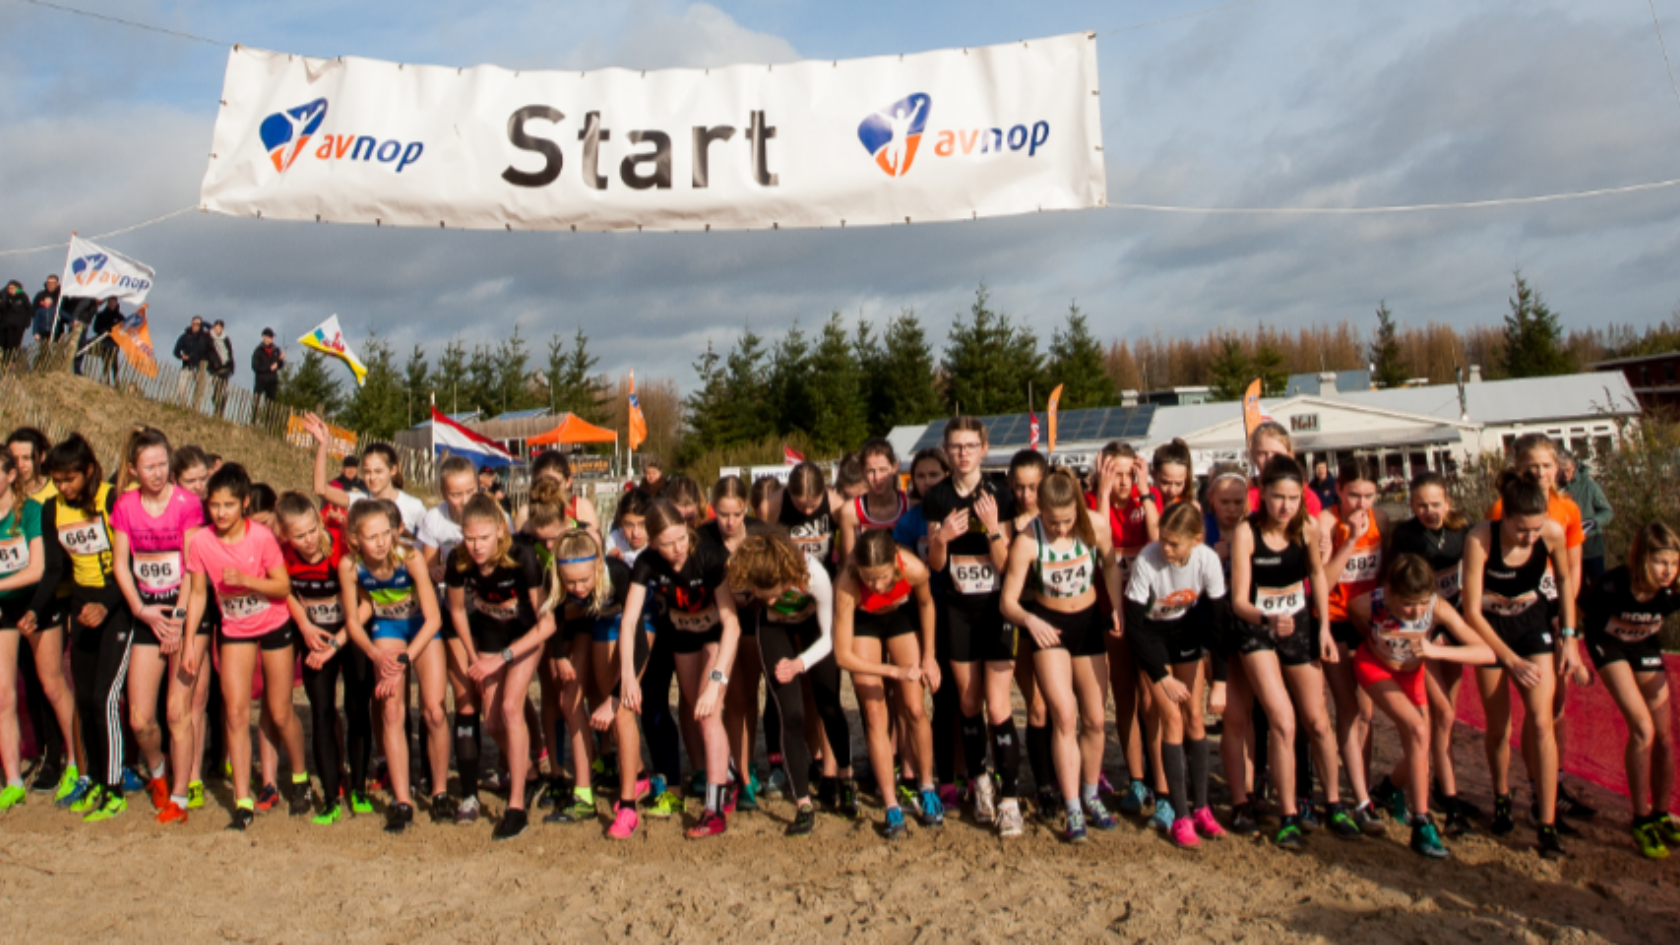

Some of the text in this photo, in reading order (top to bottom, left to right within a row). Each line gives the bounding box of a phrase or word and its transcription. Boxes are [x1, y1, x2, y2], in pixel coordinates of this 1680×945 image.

[501, 104, 779, 189] Start
[934, 120, 1049, 156] avnop
[315, 134, 423, 172] avnop
[66, 528, 98, 546] 664
[140, 563, 172, 577] 696
[957, 566, 993, 580] 650
[1051, 565, 1087, 584] 674
